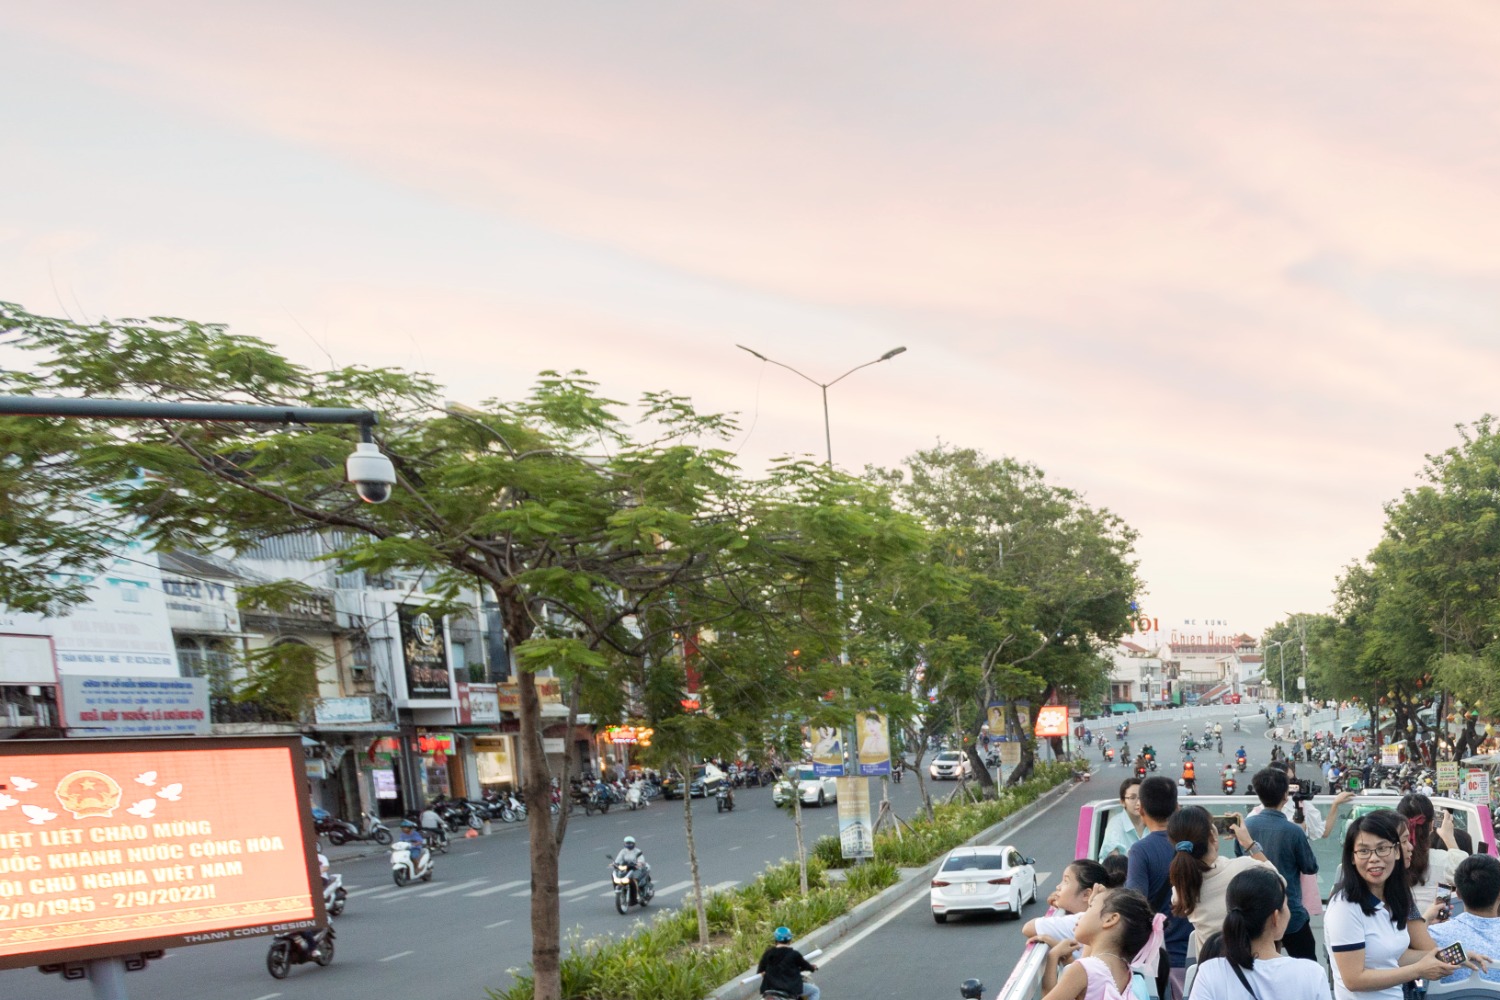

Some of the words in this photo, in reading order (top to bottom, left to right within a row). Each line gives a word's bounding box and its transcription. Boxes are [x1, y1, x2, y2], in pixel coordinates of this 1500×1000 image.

[40, 827, 84, 848] LIỆT
[90, 822, 149, 844] CHÀO
[153, 819, 213, 841] MỪNG
[47, 848, 122, 871] KHÁNH
[126, 842, 185, 864] NƯỚC
[189, 838, 243, 860] CỘNG
[246, 834, 285, 854] HÒA
[29, 872, 78, 896] CHỦ
[82, 866, 150, 890] NGHĨA
[152, 864, 196, 884] VIỆT
[200, 860, 244, 880] NAM
[184, 930, 231, 944] THANH
[233, 925, 269, 939] CONG
[272, 919, 317, 934] DESIGN
